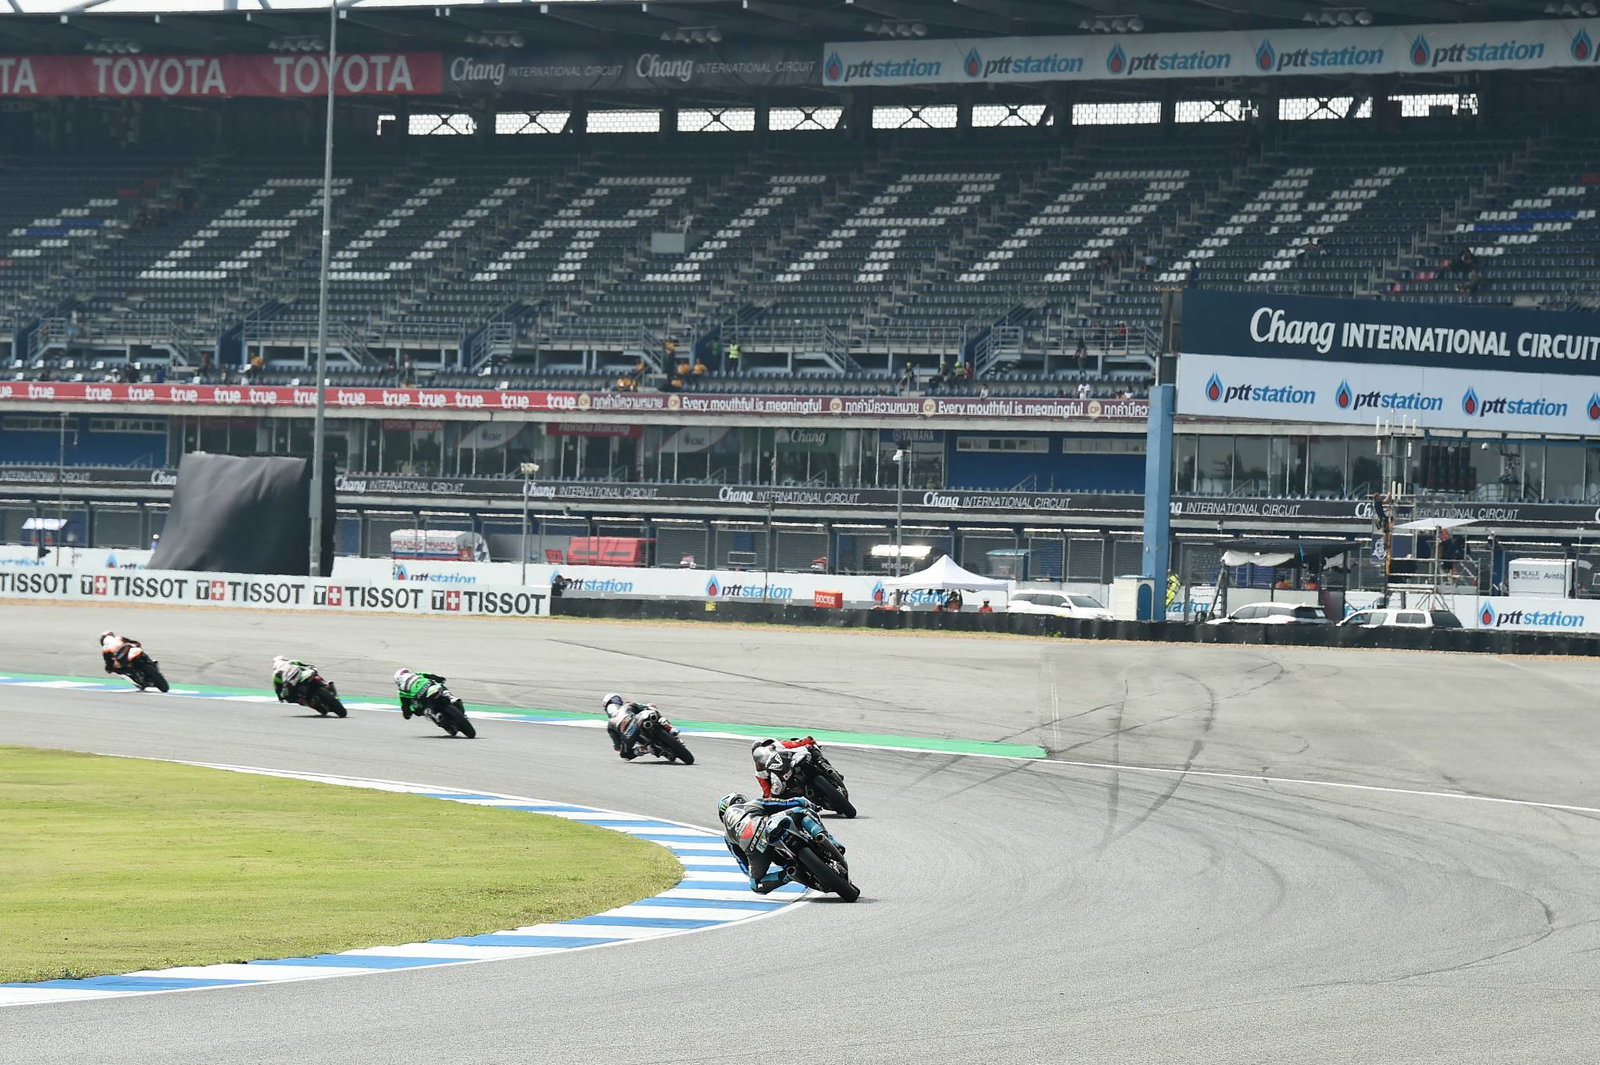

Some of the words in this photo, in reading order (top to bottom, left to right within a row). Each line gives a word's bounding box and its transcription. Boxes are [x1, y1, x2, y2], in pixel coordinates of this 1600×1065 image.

[273, 54, 414, 94] TOYOTA
[451, 57, 506, 86] Chang
[508, 65, 582, 78] INTERNATIONAL
[584, 65, 624, 78] CIRCUIT
[636, 53, 694, 82] Chang
[696, 62, 773, 75] INTERNATIONAL
[775, 60, 816, 73] CIRCUIT
[93, 58, 227, 95] TOYOTA
[1250, 307, 1336, 355] Chang
[1342, 322, 1512, 358] INTERNATIONAL
[1517, 332, 1600, 361] CIRCUIT
[86, 386, 112, 401] true
[128, 386, 155, 401] true
[171, 387, 198, 402] true
[214, 387, 241, 403] true
[249, 388, 277, 404] true
[338, 390, 366, 405] true
[383, 390, 410, 406] true
[418, 390, 446, 407] true
[455, 391, 484, 407] true
[501, 392, 529, 408] true
[547, 393, 576, 409] true
[683, 397, 707, 412] Every
[710, 397, 754, 411] mouthful
[756, 398, 765, 411] is
[766, 398, 822, 413] meaningful
[938, 401, 965, 416] Every
[967, 401, 1013, 415] mouthful
[1014, 402, 1023, 415] is
[1024, 401, 1083, 417] meaningful
[791, 429, 827, 447] Chang
[902, 430, 934, 441] YAMAHA
[335, 476, 367, 494] Chang
[368, 480, 429, 492] INTERNATIONAL
[431, 481, 464, 493] CIRCUIT
[523, 480, 556, 497] Chang
[559, 485, 621, 498] INTERNATIONAL
[623, 487, 658, 499] CIRCUIT
[719, 485, 754, 504] Chang
[757, 491, 825, 504] INTERNATIONAL
[826, 493, 860, 505] CIRCUIT
[923, 491, 960, 511] Chang
[962, 495, 1033, 508] INTERNATIONAL
[1034, 497, 1071, 509] CIRCUIT
[1187, 502, 1258, 515] INTERNATIONAL
[1262, 504, 1301, 517] CIRCUIT
[1478, 508, 1520, 521] CIRCUIT
[0, 573, 73, 595] TISSOT
[110, 576, 187, 600] TISSOT
[227, 580, 305, 604] TISSOT
[344, 585, 424, 610] TISSOT
[463, 591, 546, 615] TISSOT
